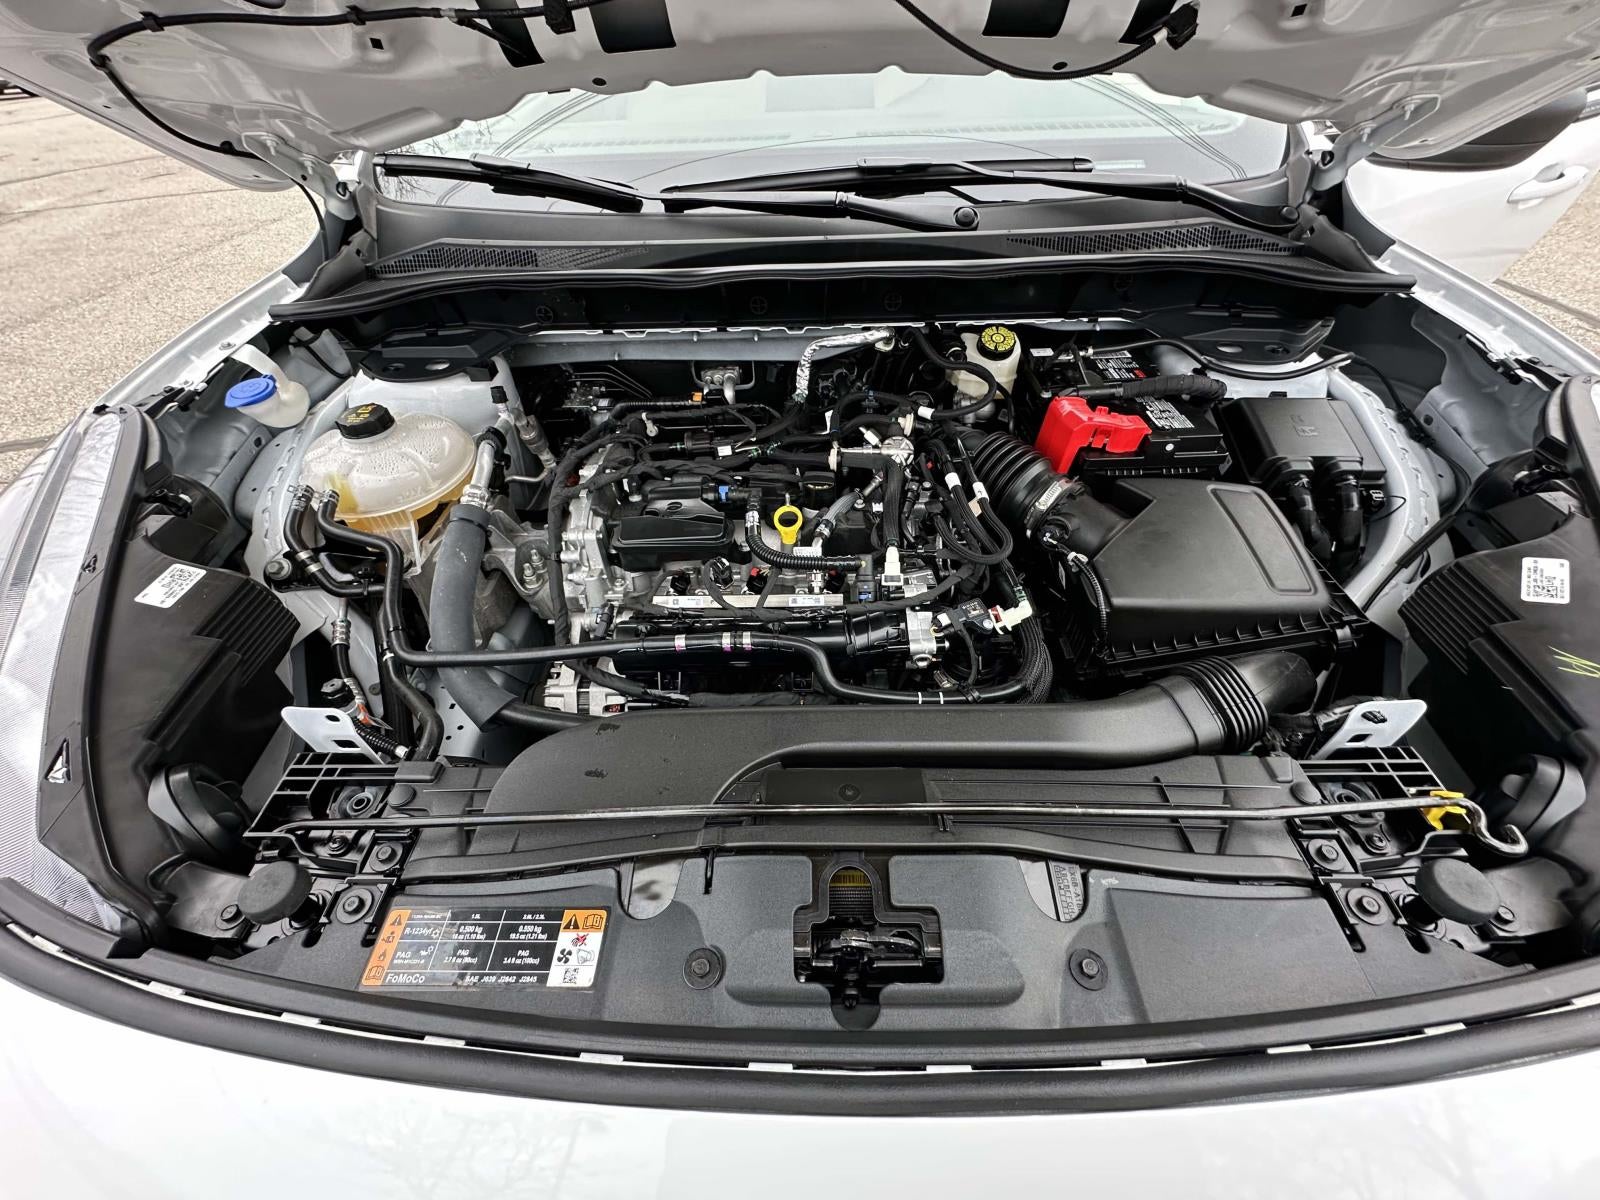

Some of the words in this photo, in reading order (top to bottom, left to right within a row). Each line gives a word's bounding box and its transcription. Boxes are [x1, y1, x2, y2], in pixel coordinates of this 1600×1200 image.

[404, 927, 432, 936] R-1234yf
[475, 925, 483, 934] kg
[534, 925, 542, 934] kg
[517, 949, 530, 957] PAG
[385, 973, 426, 984] FoMoCo
